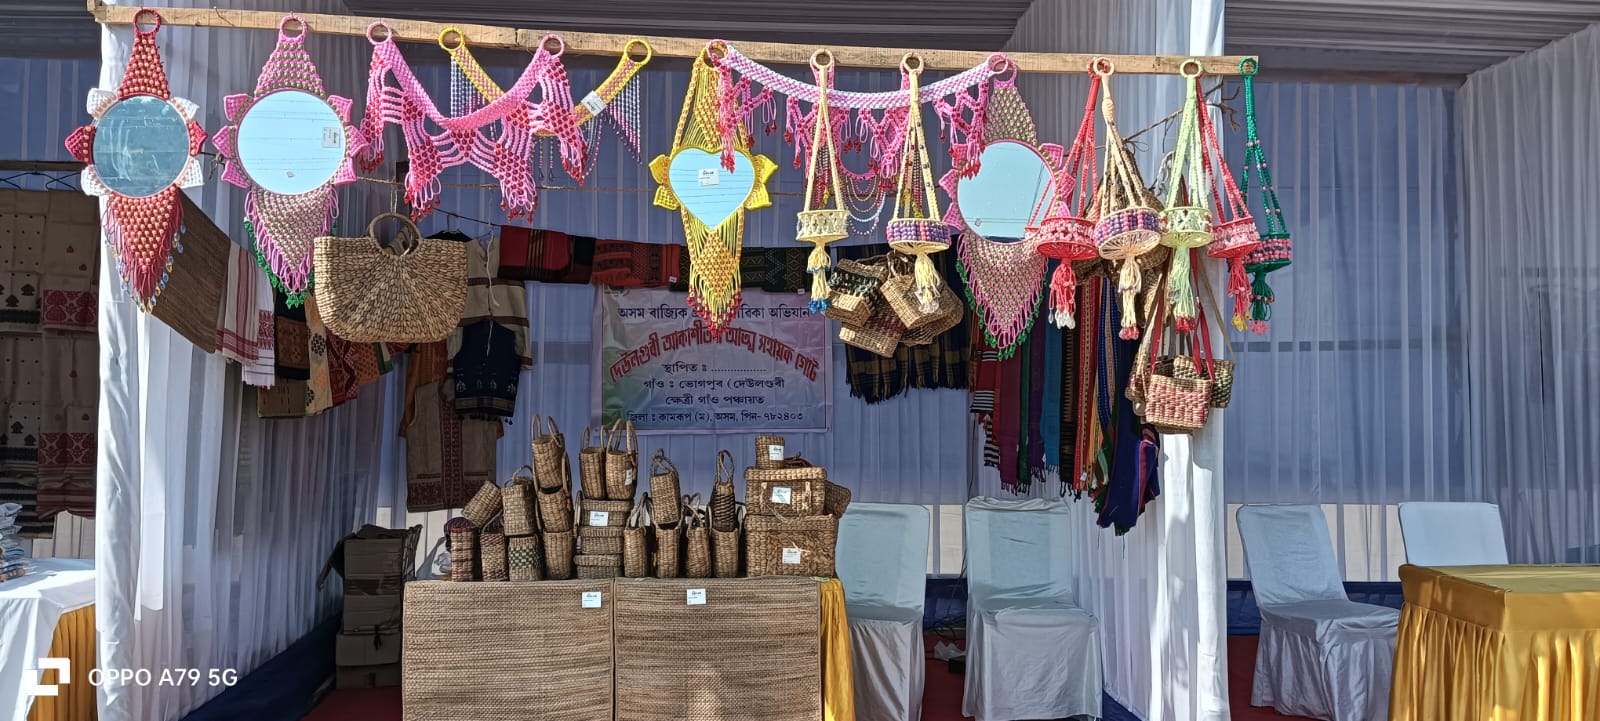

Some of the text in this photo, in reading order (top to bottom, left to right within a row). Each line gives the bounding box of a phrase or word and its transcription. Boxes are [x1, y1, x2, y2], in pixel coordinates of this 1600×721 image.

[618, 308, 644, 319] অসম
[768, 304, 809, 319] অভিযান
[759, 334, 795, 364] সহায়ক
[796, 353, 819, 382] গোট
[661, 361, 698, 375] স্থাপিত
[644, 378, 664, 388] গাঁও
[698, 394, 719, 404] গাঁও
